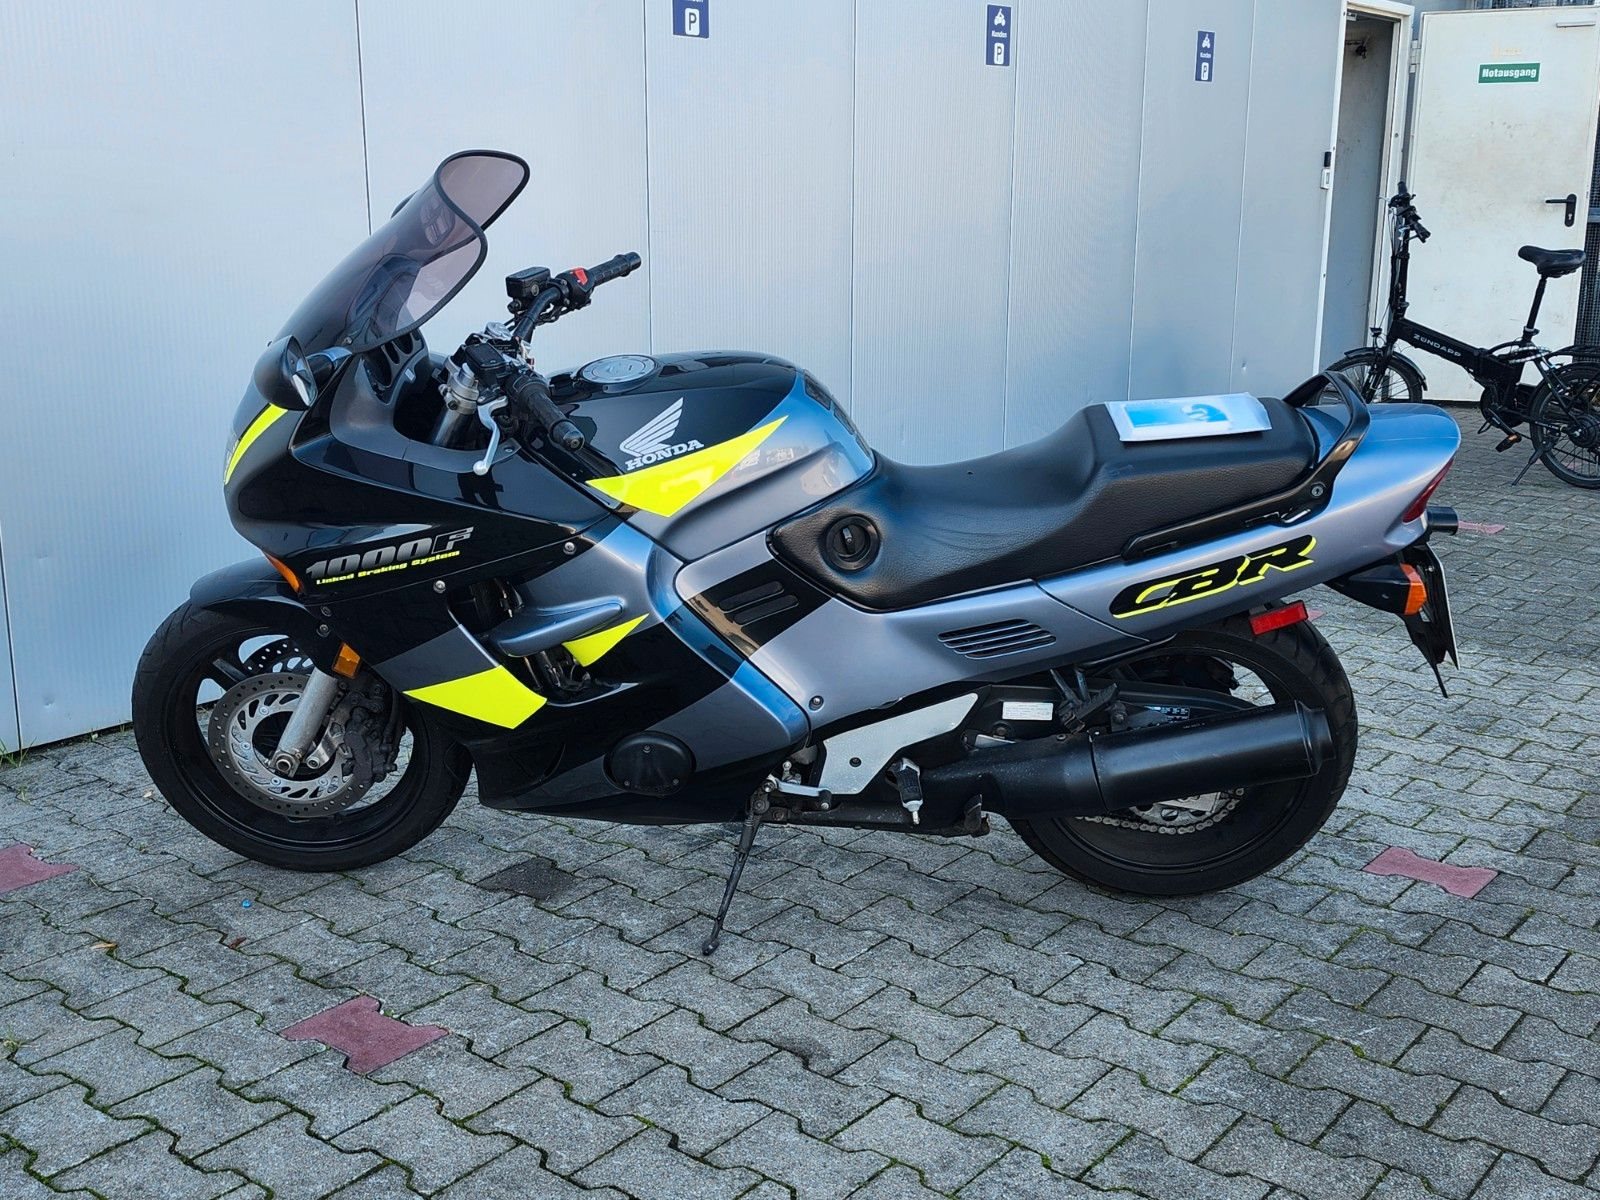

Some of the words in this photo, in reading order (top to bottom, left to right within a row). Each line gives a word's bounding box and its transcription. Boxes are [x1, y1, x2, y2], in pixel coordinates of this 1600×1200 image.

[688, 12, 697, 31] P
[1481, 68, 1537, 79] Notausgang
[625, 439, 704, 471] HONDA
[316, 573, 355, 585] Linked
[357, 562, 408, 578] Braking
[411, 550, 461, 566] System
[1109, 534, 1317, 619] CBR
